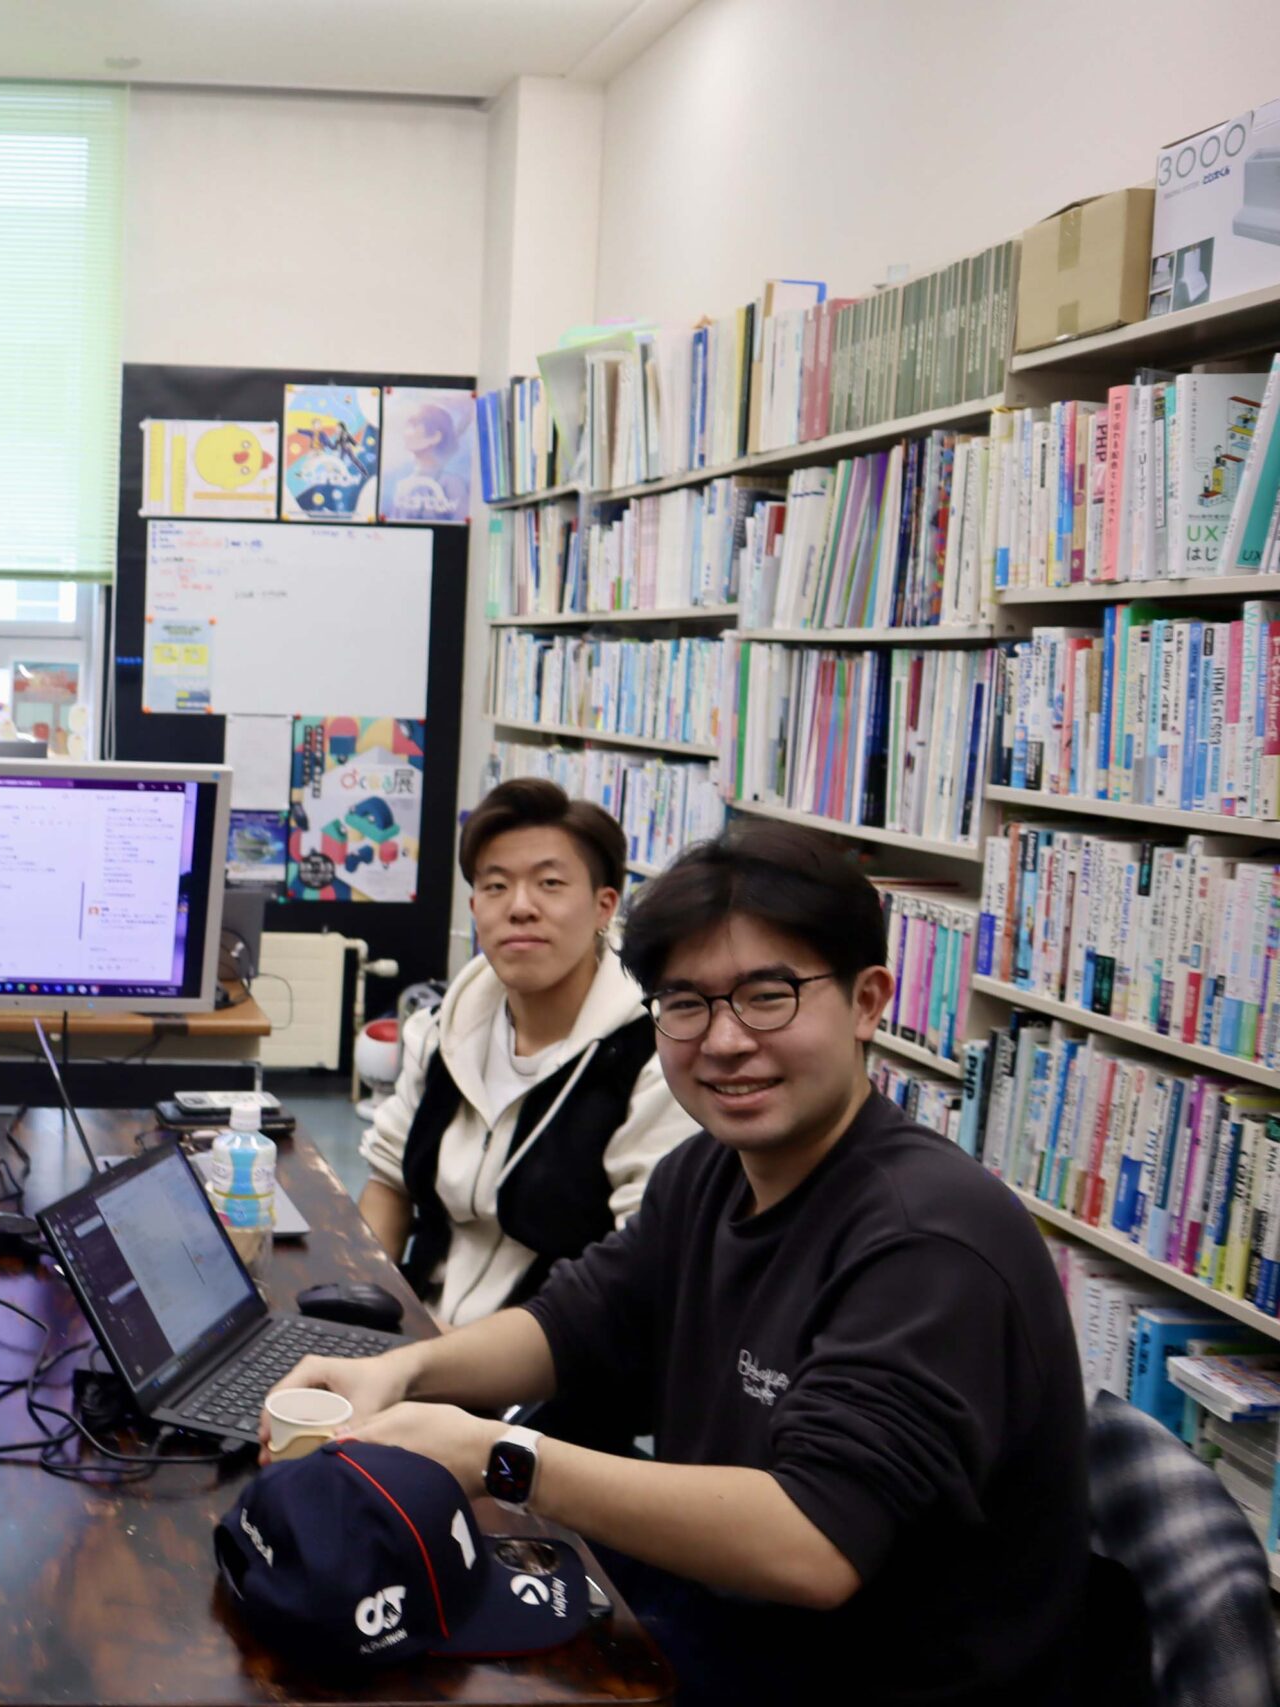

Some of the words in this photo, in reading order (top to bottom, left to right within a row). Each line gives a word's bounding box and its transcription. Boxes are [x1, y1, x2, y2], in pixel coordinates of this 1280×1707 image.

[1158, 123, 1246, 187] 3000
[1095, 424, 1108, 462] PHP
[1161, 650, 1174, 691] jQuery
[1241, 604, 1260, 712] WordPress
[1211, 667, 1225, 705] HTML5
[1080, 848, 1092, 896] KINECT
[1255, 870, 1272, 914] Unity
[965, 1055, 979, 1101] PHP
[1104, 1299, 1120, 1381] WordPress
